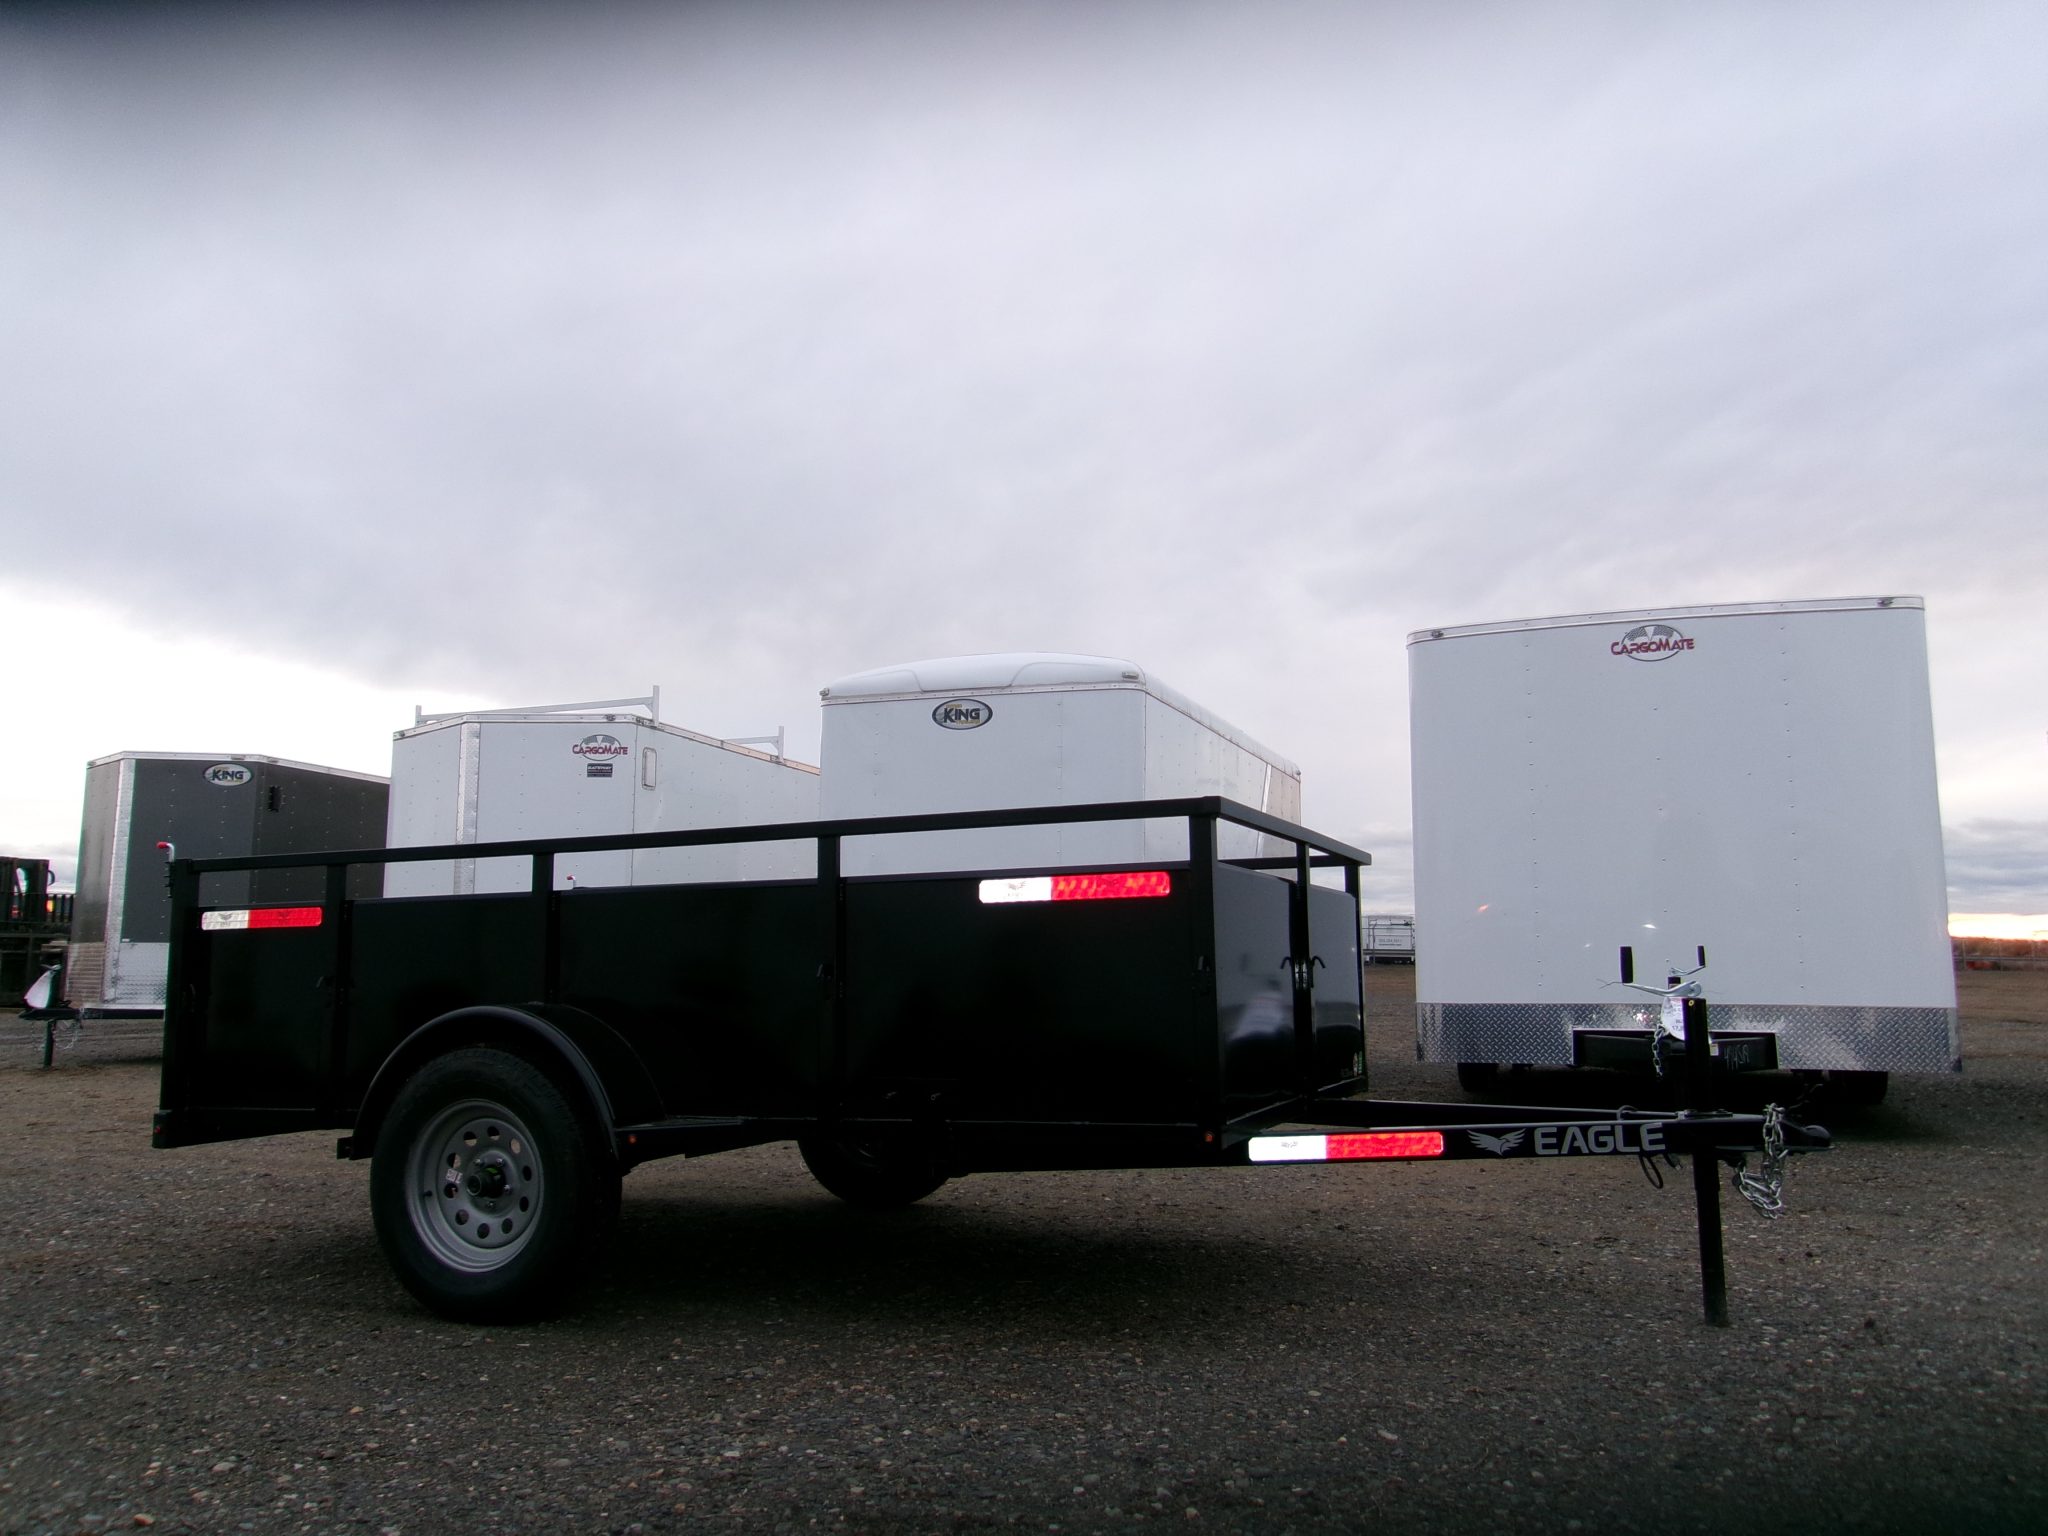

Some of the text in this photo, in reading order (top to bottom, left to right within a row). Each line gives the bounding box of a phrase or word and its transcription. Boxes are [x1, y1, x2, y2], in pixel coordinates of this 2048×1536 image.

[1611, 638, 1695, 655] CARGOMATE
[943, 708, 980, 723] KING
[572, 744, 628, 756] CARGOMATE
[212, 768, 244, 781] KING
[1533, 1122, 1666, 1155] EAGLE
